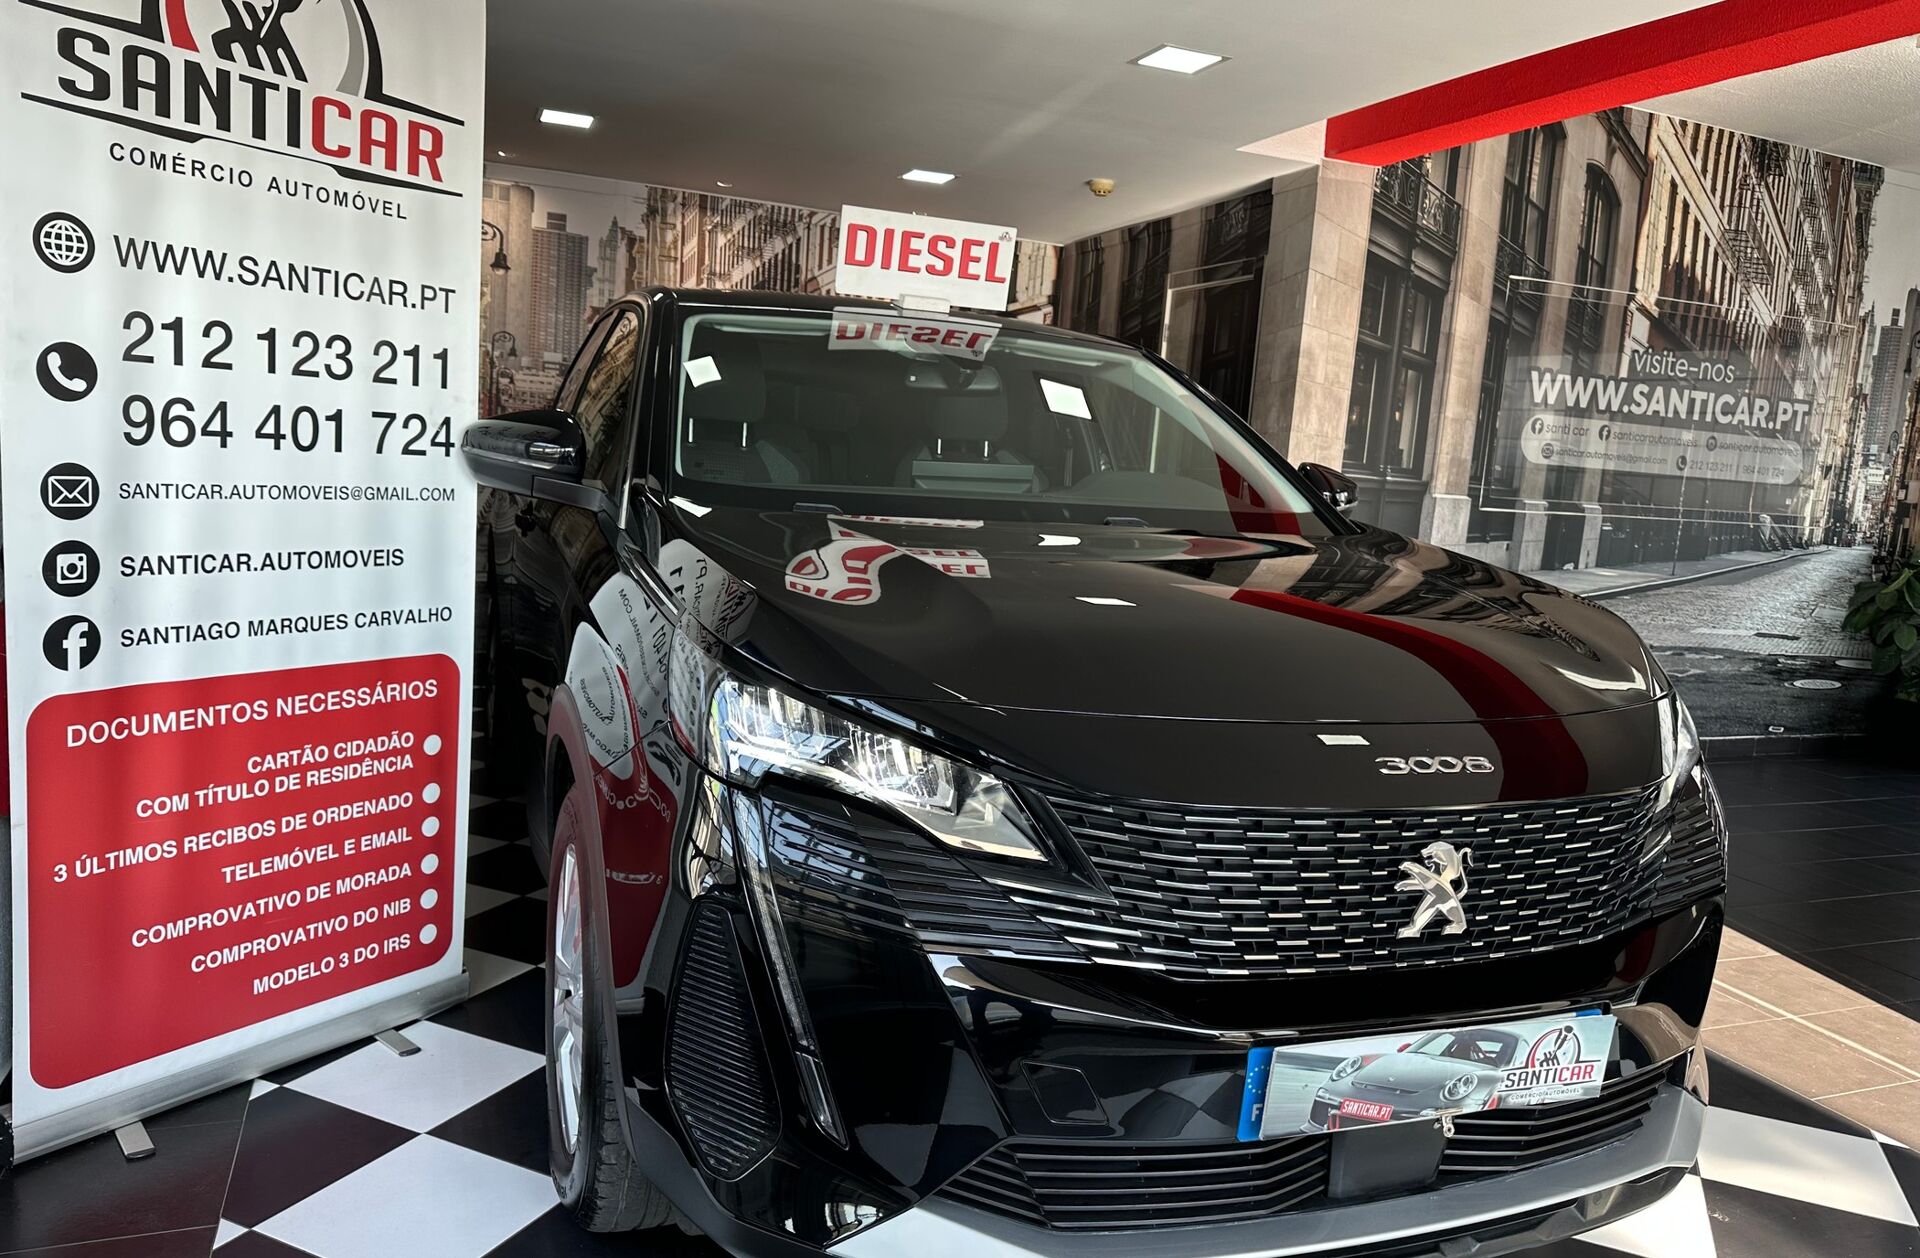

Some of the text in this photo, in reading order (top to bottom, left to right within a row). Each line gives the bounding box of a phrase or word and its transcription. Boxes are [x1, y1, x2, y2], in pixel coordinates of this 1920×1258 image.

[57, 27, 444, 182] SANTICAR
[109, 142, 408, 219] COMÉRCIO AUTOMÓVEL
[113, 235, 456, 313] WWW.SANTICAR.PT
[844, 223, 1006, 283] DIESEL
[122, 311, 449, 390] 212 123 211
[1633, 350, 1735, 383] visite-nos
[122, 394, 455, 457] 964 401 724
[1531, 370, 1809, 431] WWW.SANTICAR.PT
[119, 483, 455, 502] SANTICAR.AUTOMOVEIS@GMAIL.COM
[120, 548, 404, 577] SANTICAR.AUTOMOVEIS
[120, 606, 452, 647] SANTIAGO MARQUES CARVALHO
[67, 679, 438, 747] DOCUMENTOS NECESSÁRIOS
[247, 732, 414, 774] CARTÃO CIDADÃO
[1375, 756, 1495, 774] 3008
[136, 755, 413, 818] COM TÍTULO DE RESIDÊNCIA
[53, 792, 413, 883] 3 ÚLTIMOS RECIBOS DE ORDENADO
[222, 827, 412, 884] TELEMÓVEL E EMAIL
[131, 863, 412, 948] COMPROVATIVO DE MORADA
[191, 898, 411, 974] COMPROVATIVO DO NIB
[253, 934, 410, 995] MODELO 3 DO IRS
[1505, 1064, 1594, 1088] SANTICAR
[1251, 1103, 1263, 1121] F
[1342, 1101, 1391, 1119] SANTICAR.PT
